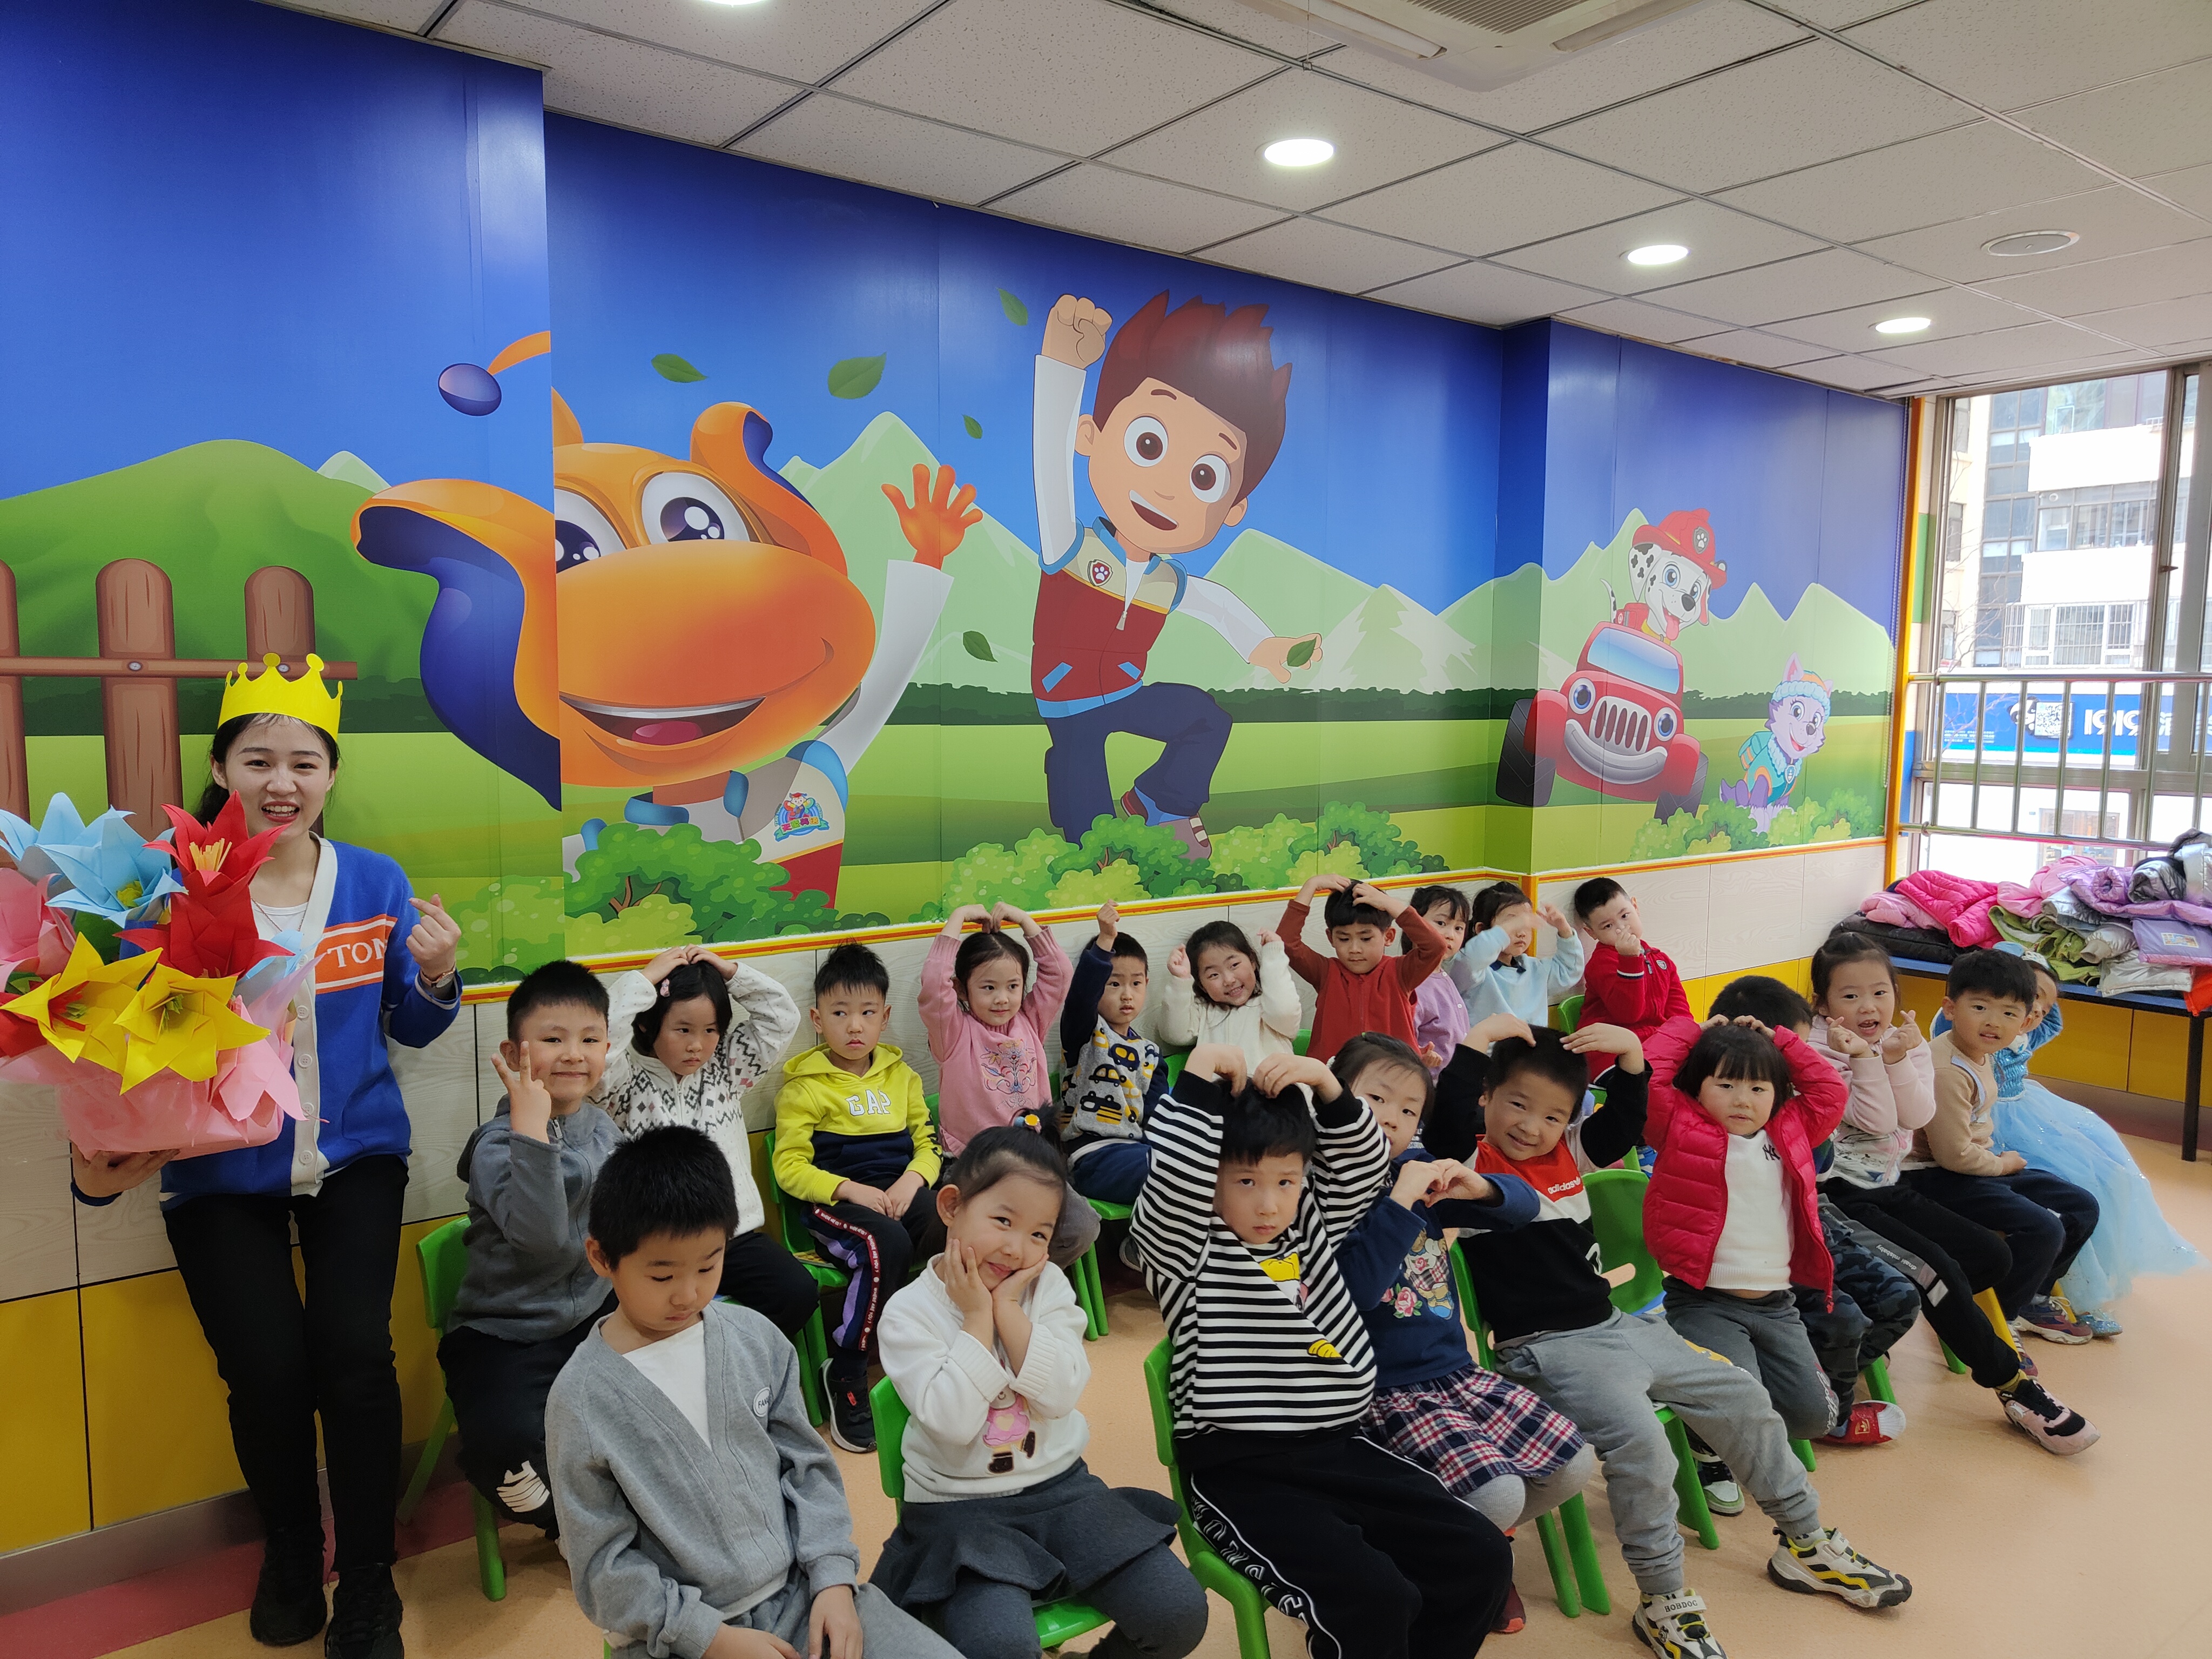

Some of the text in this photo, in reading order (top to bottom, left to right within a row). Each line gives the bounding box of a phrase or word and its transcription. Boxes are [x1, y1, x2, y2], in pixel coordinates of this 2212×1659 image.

[845, 1089, 891, 1116] GAP
[1548, 1182, 1575, 1195] adidas
[1876, 1244, 1900, 1262] misbaby
[1664, 1600, 1698, 1613] BOBDOG
